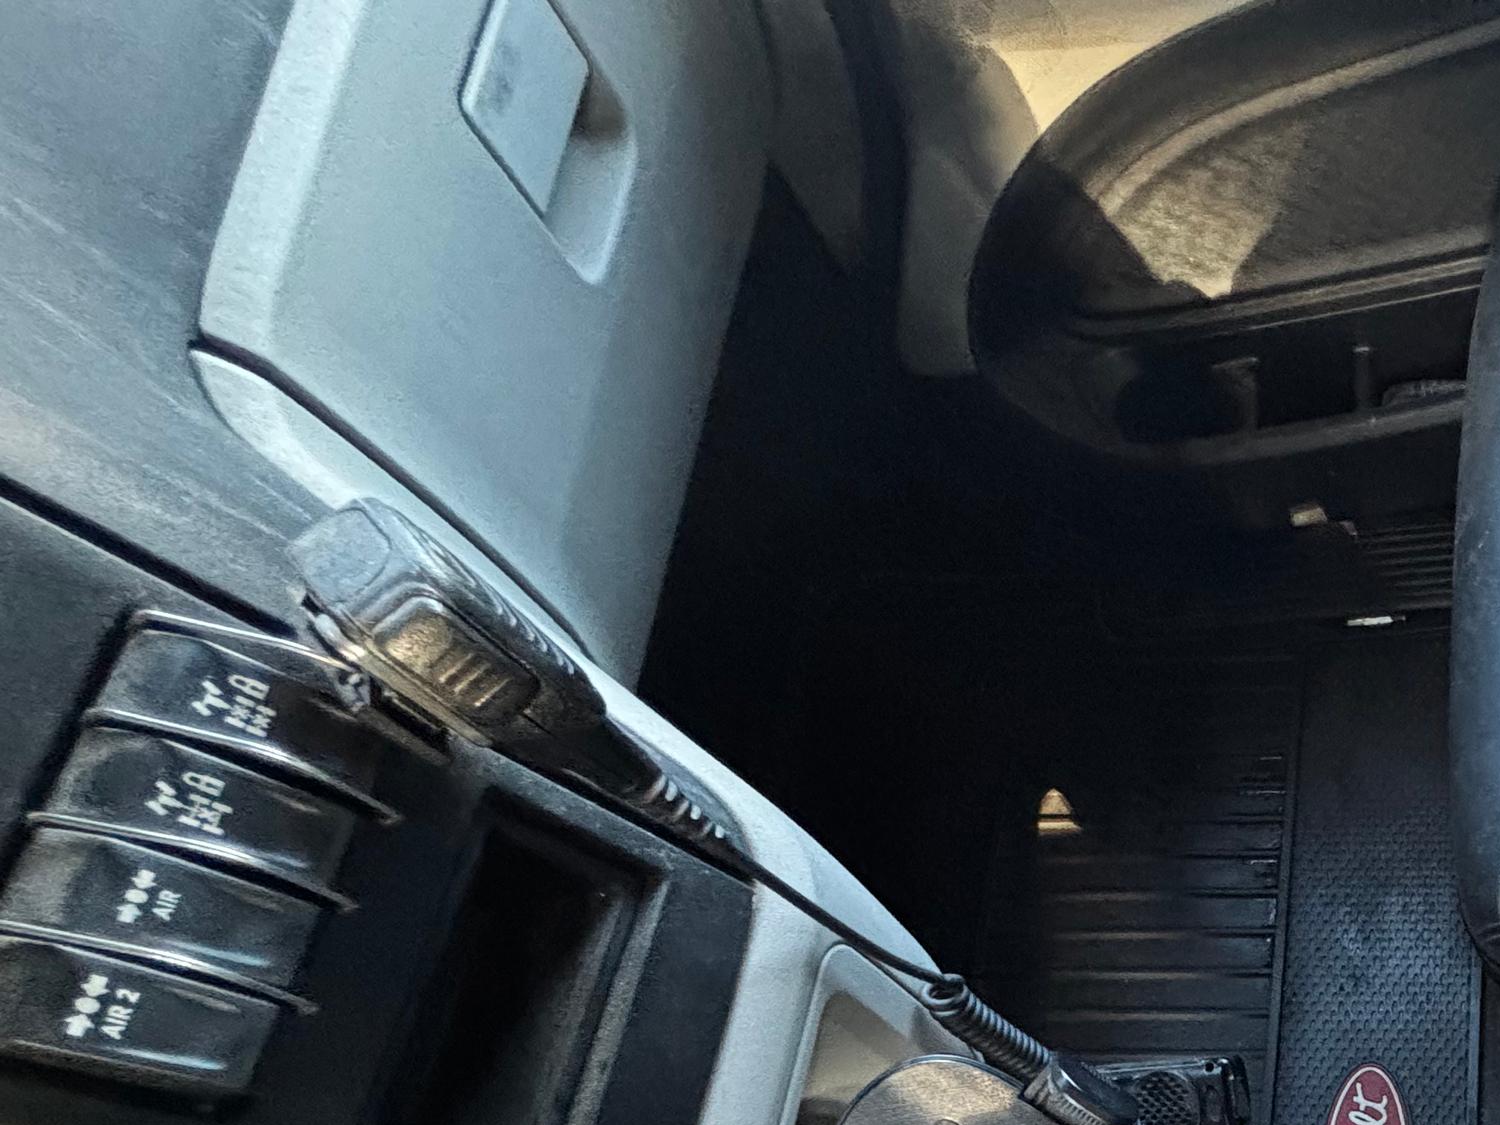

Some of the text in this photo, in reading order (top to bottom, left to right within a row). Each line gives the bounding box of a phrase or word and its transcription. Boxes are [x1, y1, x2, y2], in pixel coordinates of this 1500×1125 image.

[151, 890, 182, 921] AIR
[100, 988, 141, 1040] AIR 2
